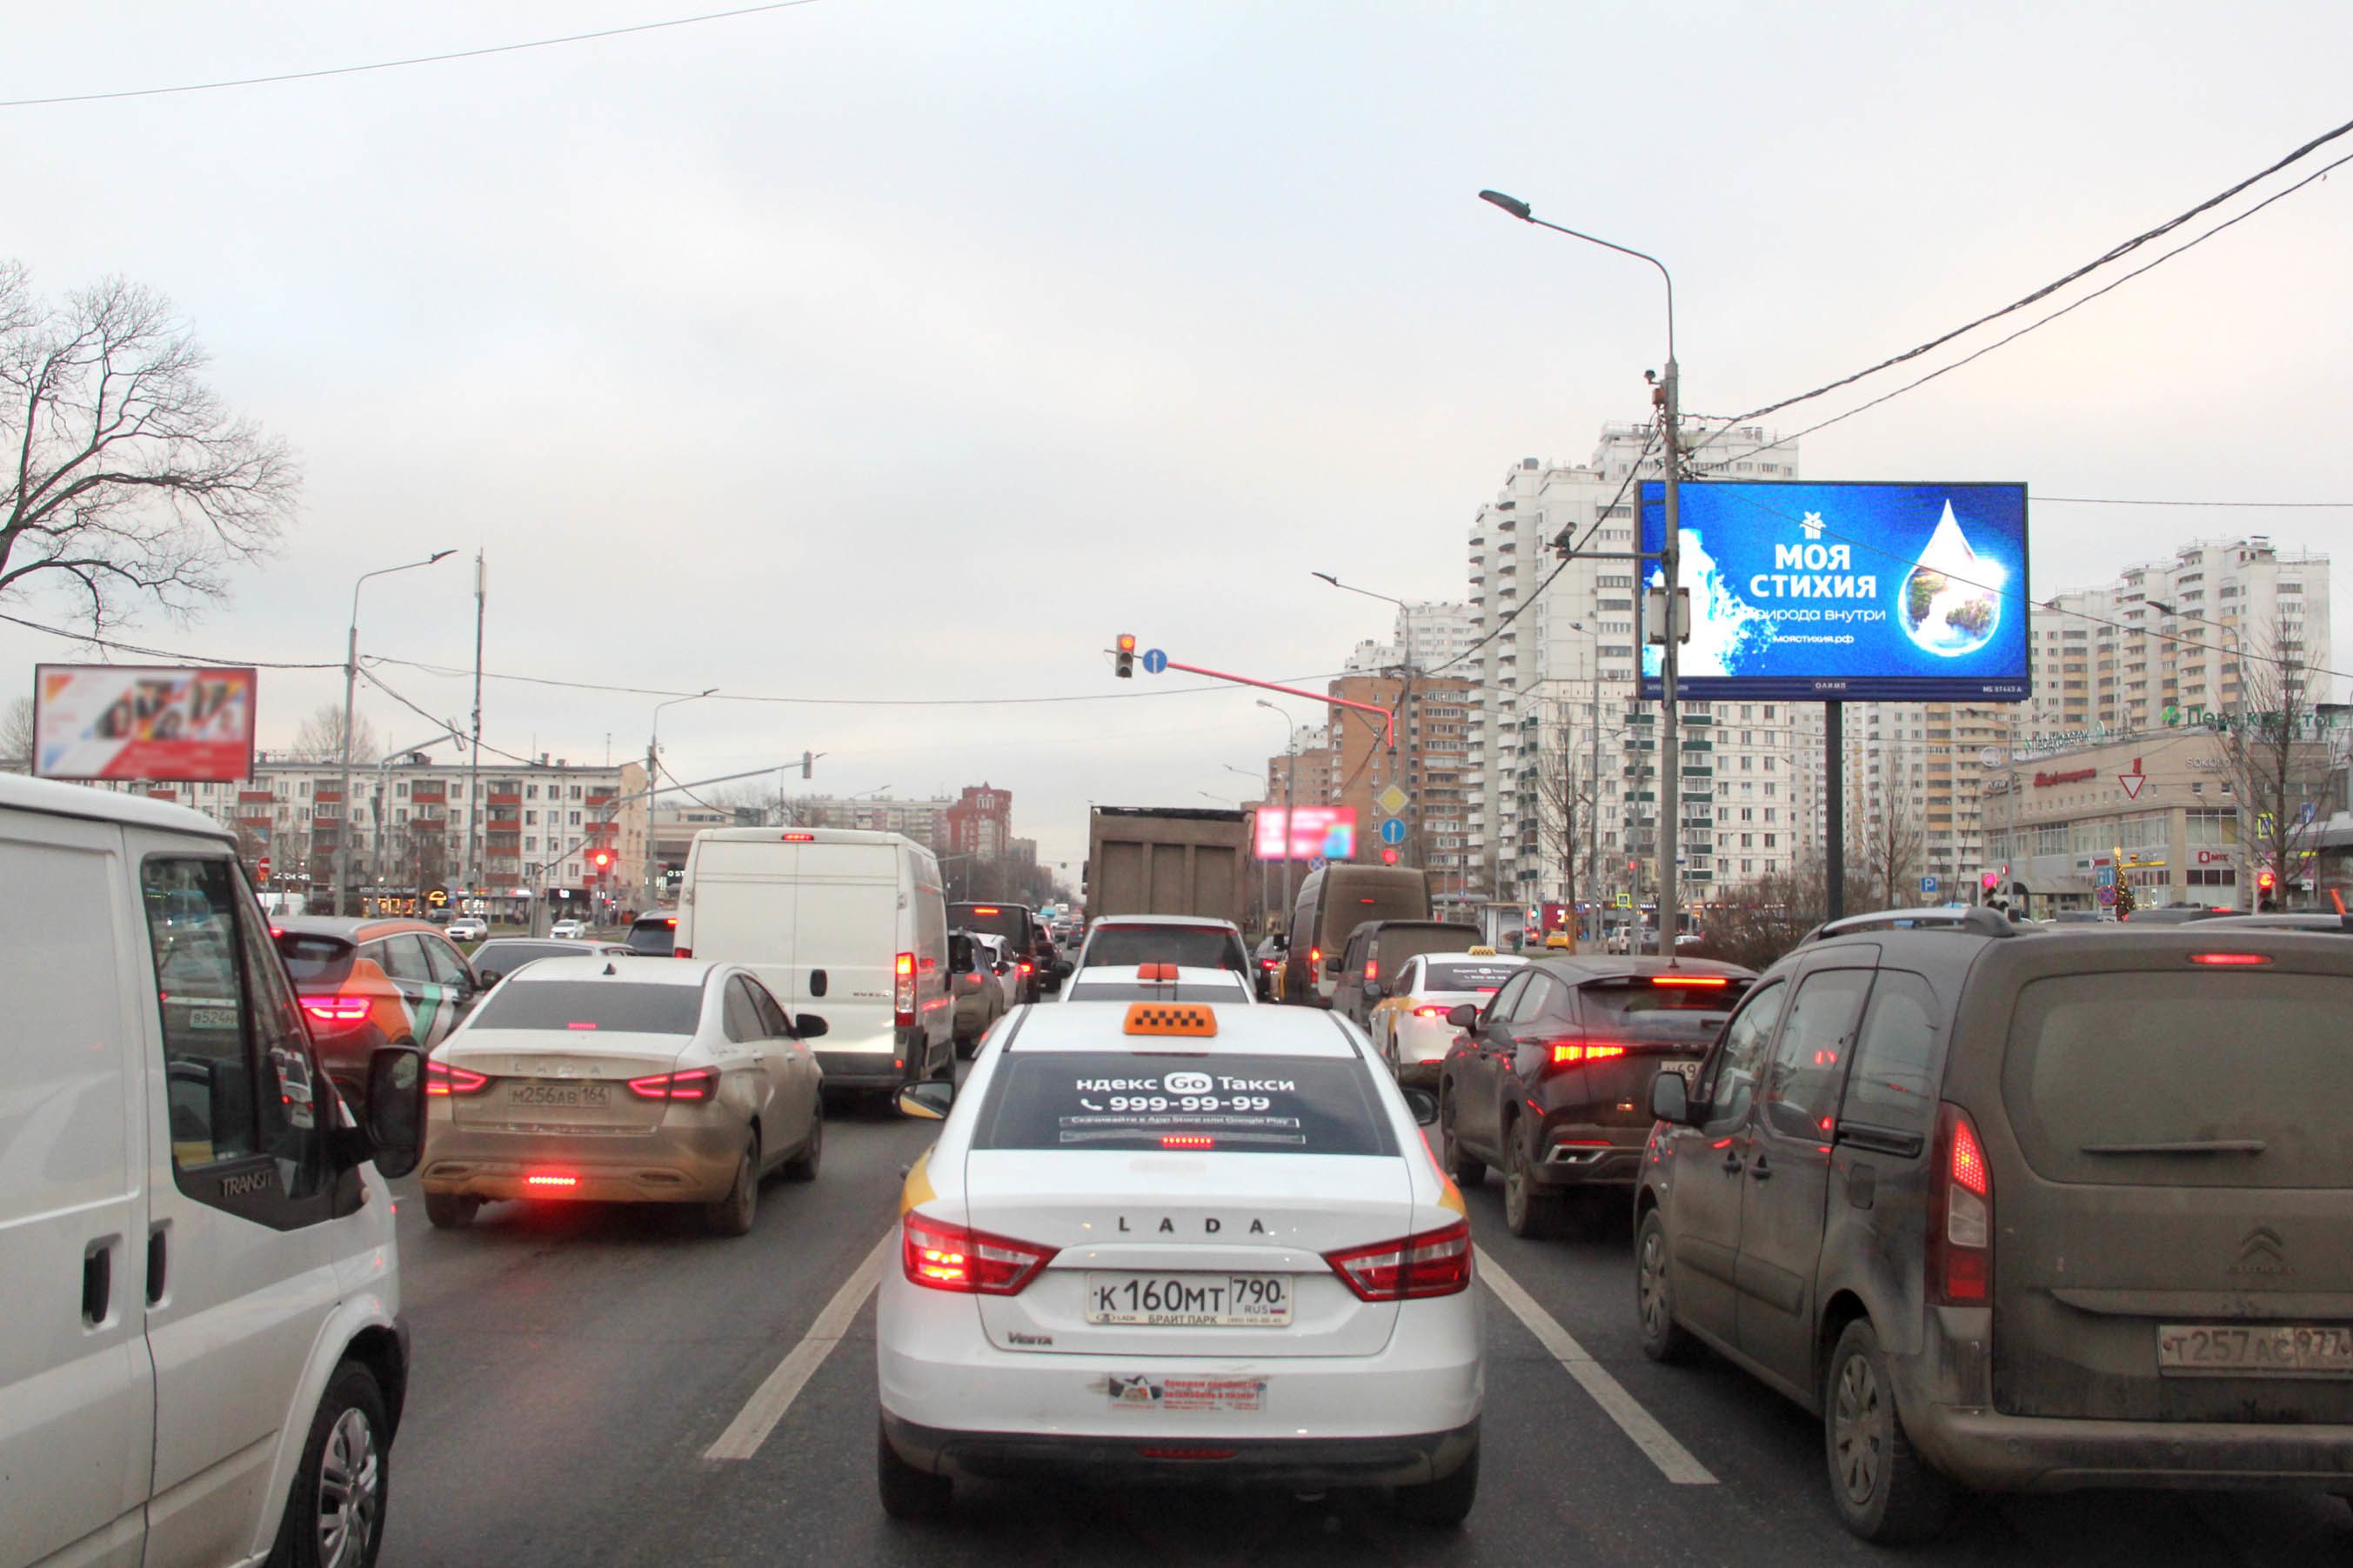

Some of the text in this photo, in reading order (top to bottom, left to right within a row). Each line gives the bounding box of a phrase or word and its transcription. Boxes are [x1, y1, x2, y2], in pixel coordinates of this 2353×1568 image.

[1775, 544, 1851, 570] МОЯ
[1749, 574, 1877, 598] СТИХИЯ
[1749, 609, 1887, 623] рирода внутри
[1772, 634, 1855, 644] моястихия.рф
[1075, 1075, 1296, 1092] ндекс Go Такси
[1109, 1096, 1271, 1112] 999-99-99
[1119, 1216, 1265, 1235] LADA
[1100, 1279, 1281, 1312] К160МТ 790
[1244, 1304, 1268, 1315] RUS
[1187, 1314, 1218, 1325] ПАРК
[2170, 1330, 2293, 1363] Т257АС
